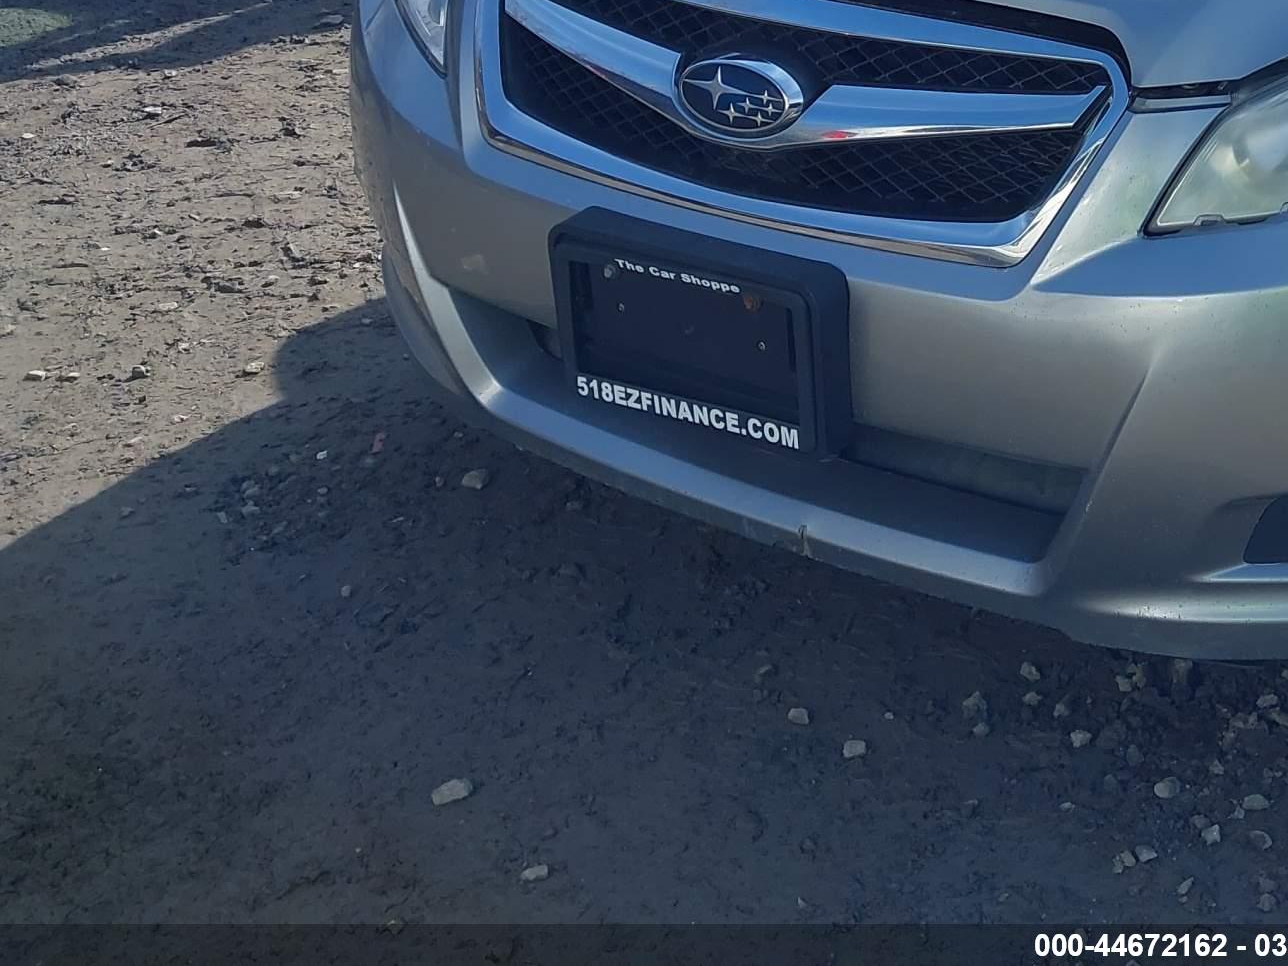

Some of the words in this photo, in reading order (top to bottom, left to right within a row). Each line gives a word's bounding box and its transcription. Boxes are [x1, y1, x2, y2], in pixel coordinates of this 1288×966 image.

[614, 258, 645, 273] The
[649, 266, 676, 280] Car
[680, 273, 741, 294] Shoppe
[576, 375, 800, 450] 518EZFINANCE.COM
